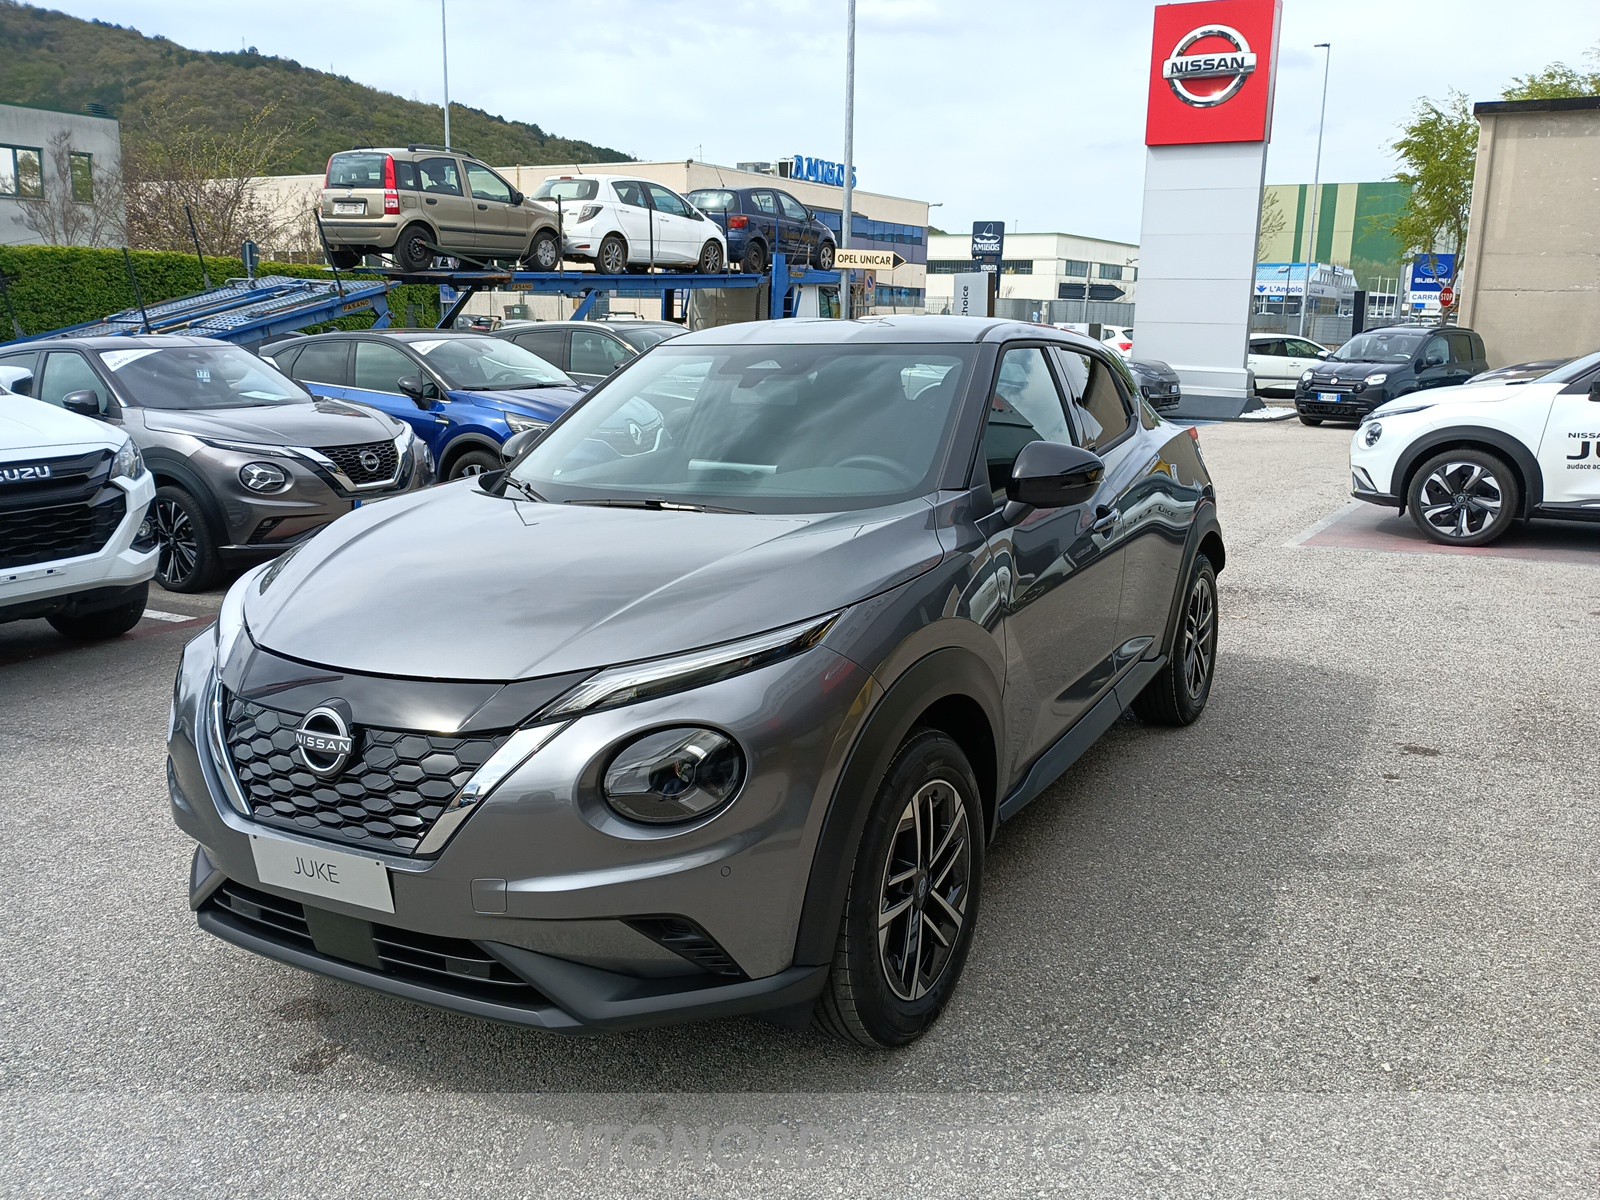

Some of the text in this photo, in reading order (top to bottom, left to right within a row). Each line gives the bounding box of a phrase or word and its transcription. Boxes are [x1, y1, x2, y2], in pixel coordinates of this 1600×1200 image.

[1170, 56, 1245, 74] NISSAN
[972, 243, 1000, 251] AMIGOS
[837, 253, 891, 265] OPEL UNICAR
[1269, 285, 1303, 294] L'Angolo
[1440, 292, 1452, 301] STOP
[343, 300, 369, 311] FASANO
[296, 733, 350, 751] NISSAN
[294, 856, 340, 884] JUKE
